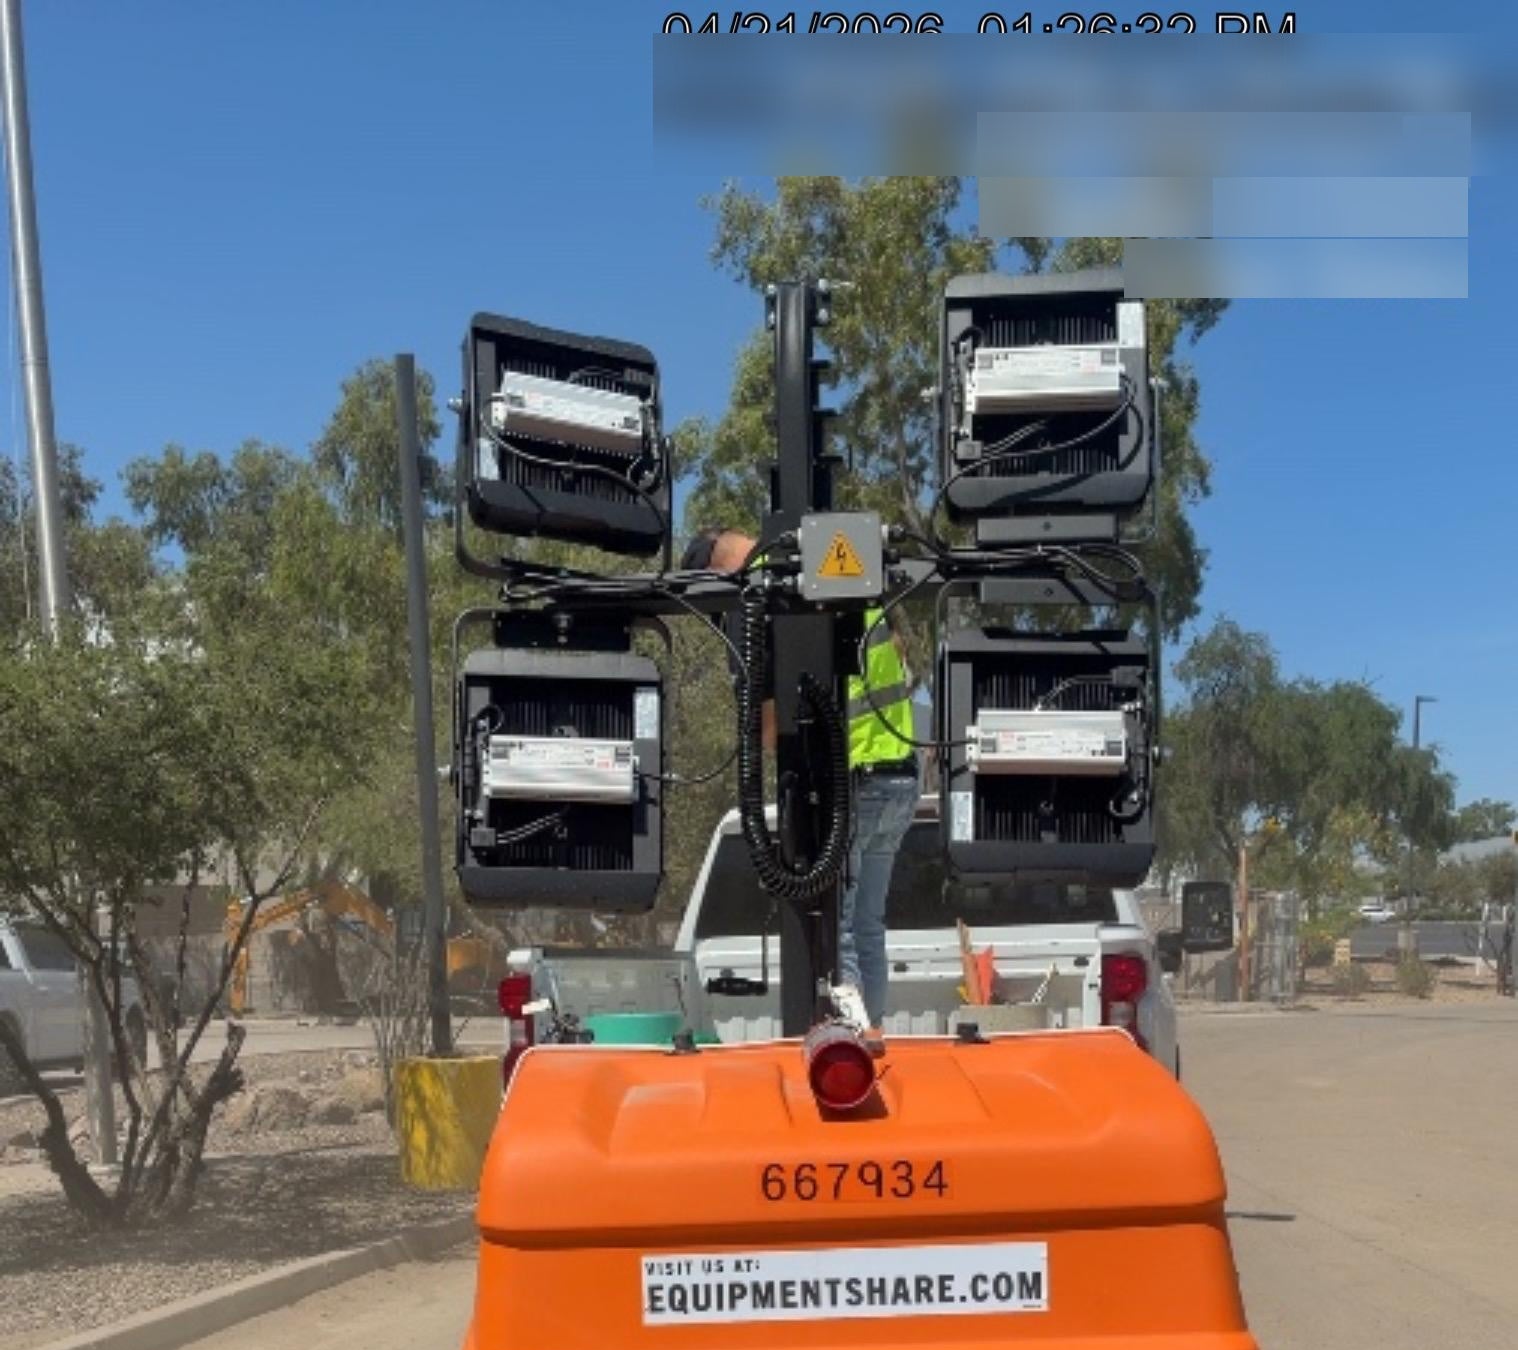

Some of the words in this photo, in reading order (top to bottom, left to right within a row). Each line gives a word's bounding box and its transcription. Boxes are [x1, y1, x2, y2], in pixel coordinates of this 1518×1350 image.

[761, 1160, 949, 1201] 667934
[645, 1261, 692, 1276] VISIT
[702, 1259, 724, 1273] US
[734, 1259, 760, 1273] AT:
[647, 1271, 1042, 1315] EQUIPMENTSHARE.COM
